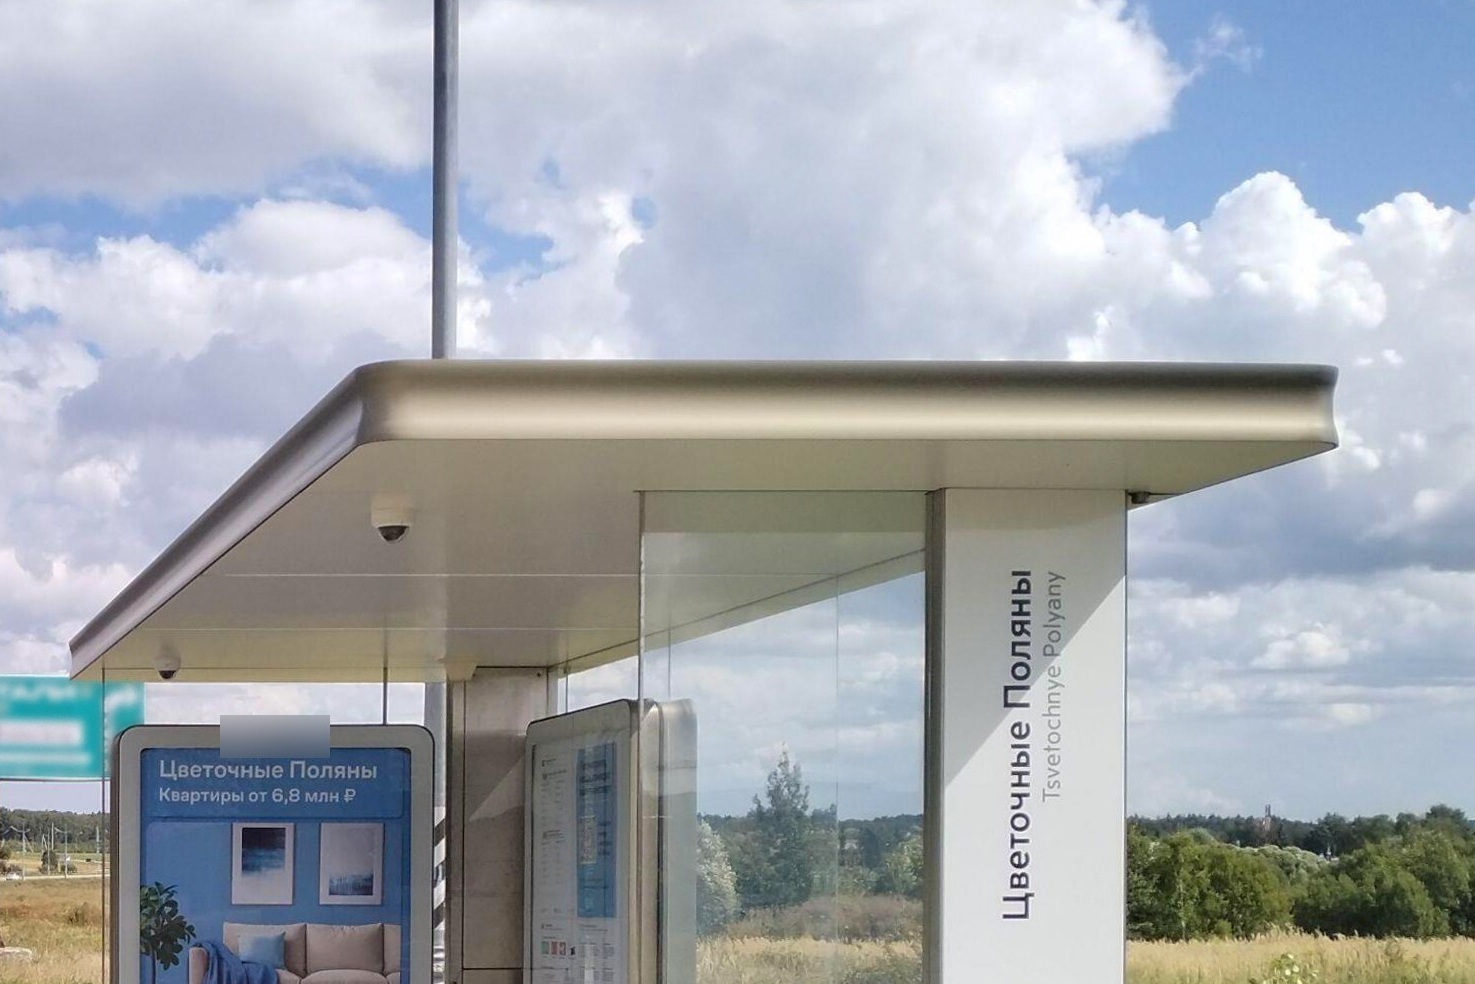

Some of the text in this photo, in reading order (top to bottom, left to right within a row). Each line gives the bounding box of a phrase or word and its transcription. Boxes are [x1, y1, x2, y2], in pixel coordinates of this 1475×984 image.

[1002, 570, 1035, 920] Цветочные Поляны
[1042, 571, 1066, 803] Tsvetochnye Polyany
[159, 760, 378, 781] Цветочные Поляны
[159, 787, 357, 805] Квартиры от 6,8 млн ₽
